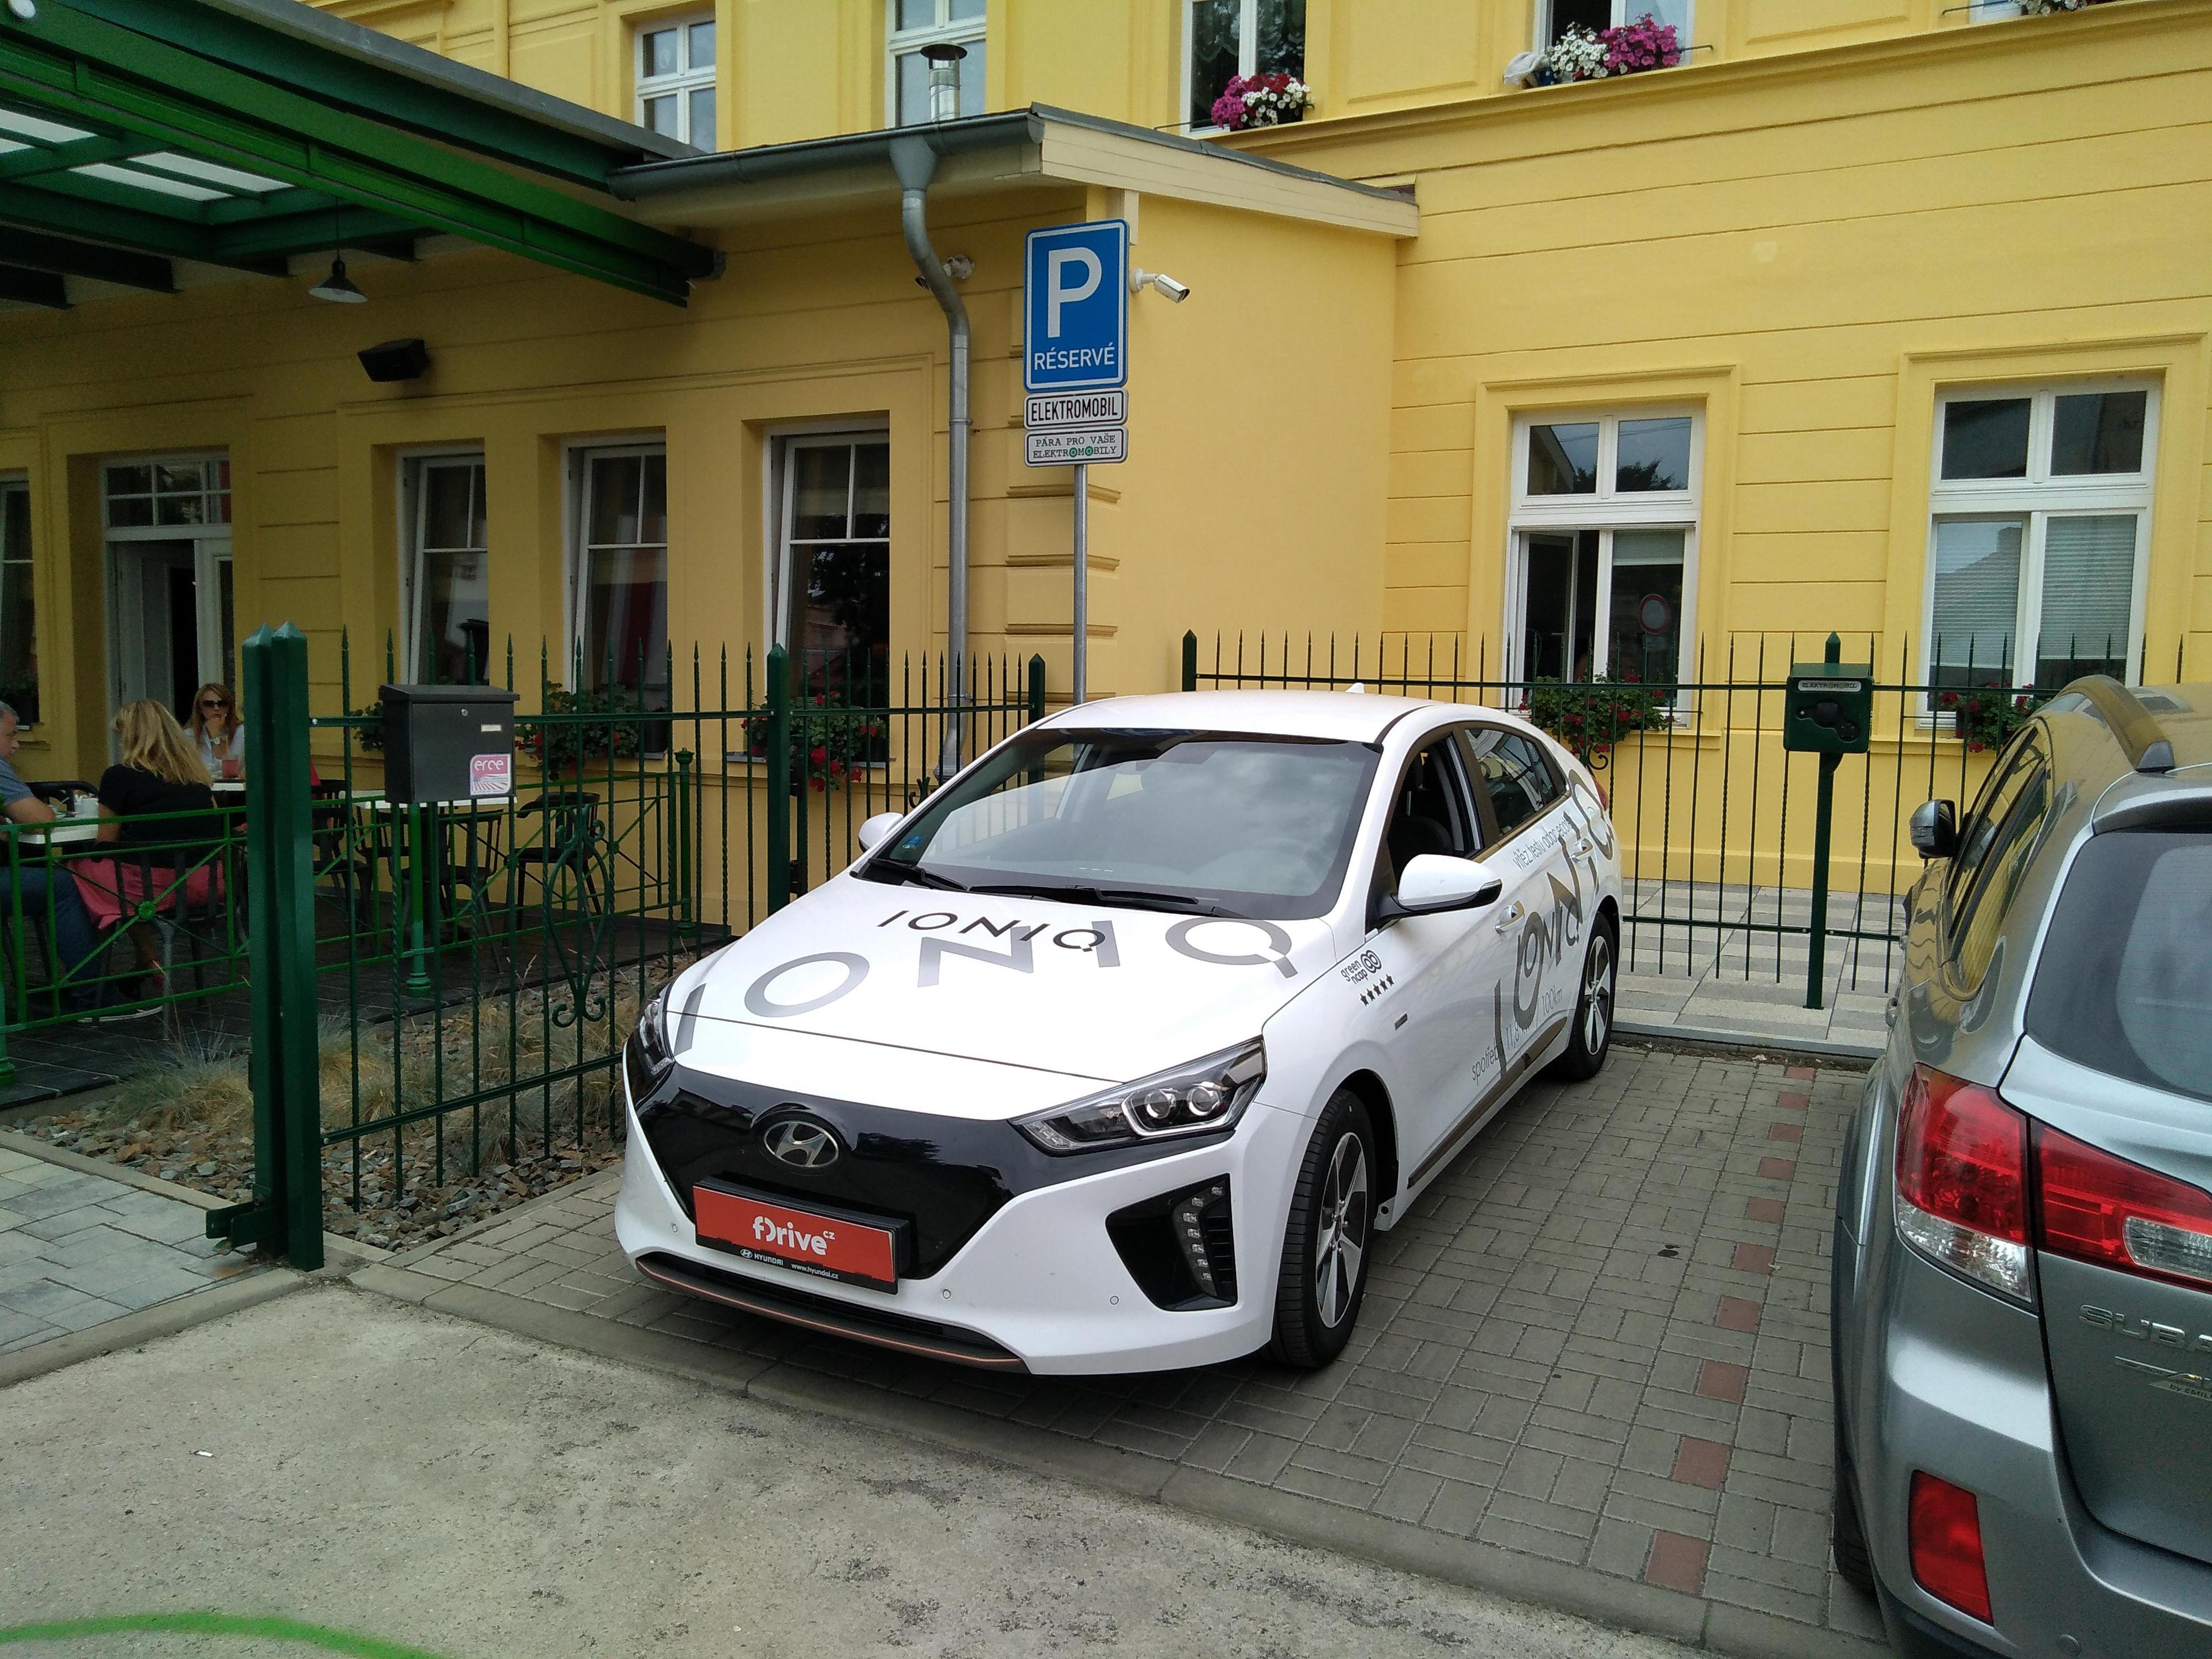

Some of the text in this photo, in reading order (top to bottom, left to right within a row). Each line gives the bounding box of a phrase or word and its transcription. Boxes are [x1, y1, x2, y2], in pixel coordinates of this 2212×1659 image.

[1047, 247, 1102, 338] P
[1034, 342, 1115, 371] RÉSERVÉ
[1031, 396, 1119, 422] ELEKTROMOBIL
[1032, 446, 1117, 458] ELEKTROMOBILY
[1035, 433, 1116, 447] PÁRA PRO VAŠE
[1525, 838, 1546, 859] testu
[877, 910, 1106, 953] IONIQ
[1340, 960, 1362, 983] green
[1350, 968, 1369, 985] ncap
[673, 914, 1298, 1057] IONIQ
[1472, 1036, 1500, 1087] spotřeb
[754, 1252, 839, 1280] HYUNDAI www.hyundai.cz
